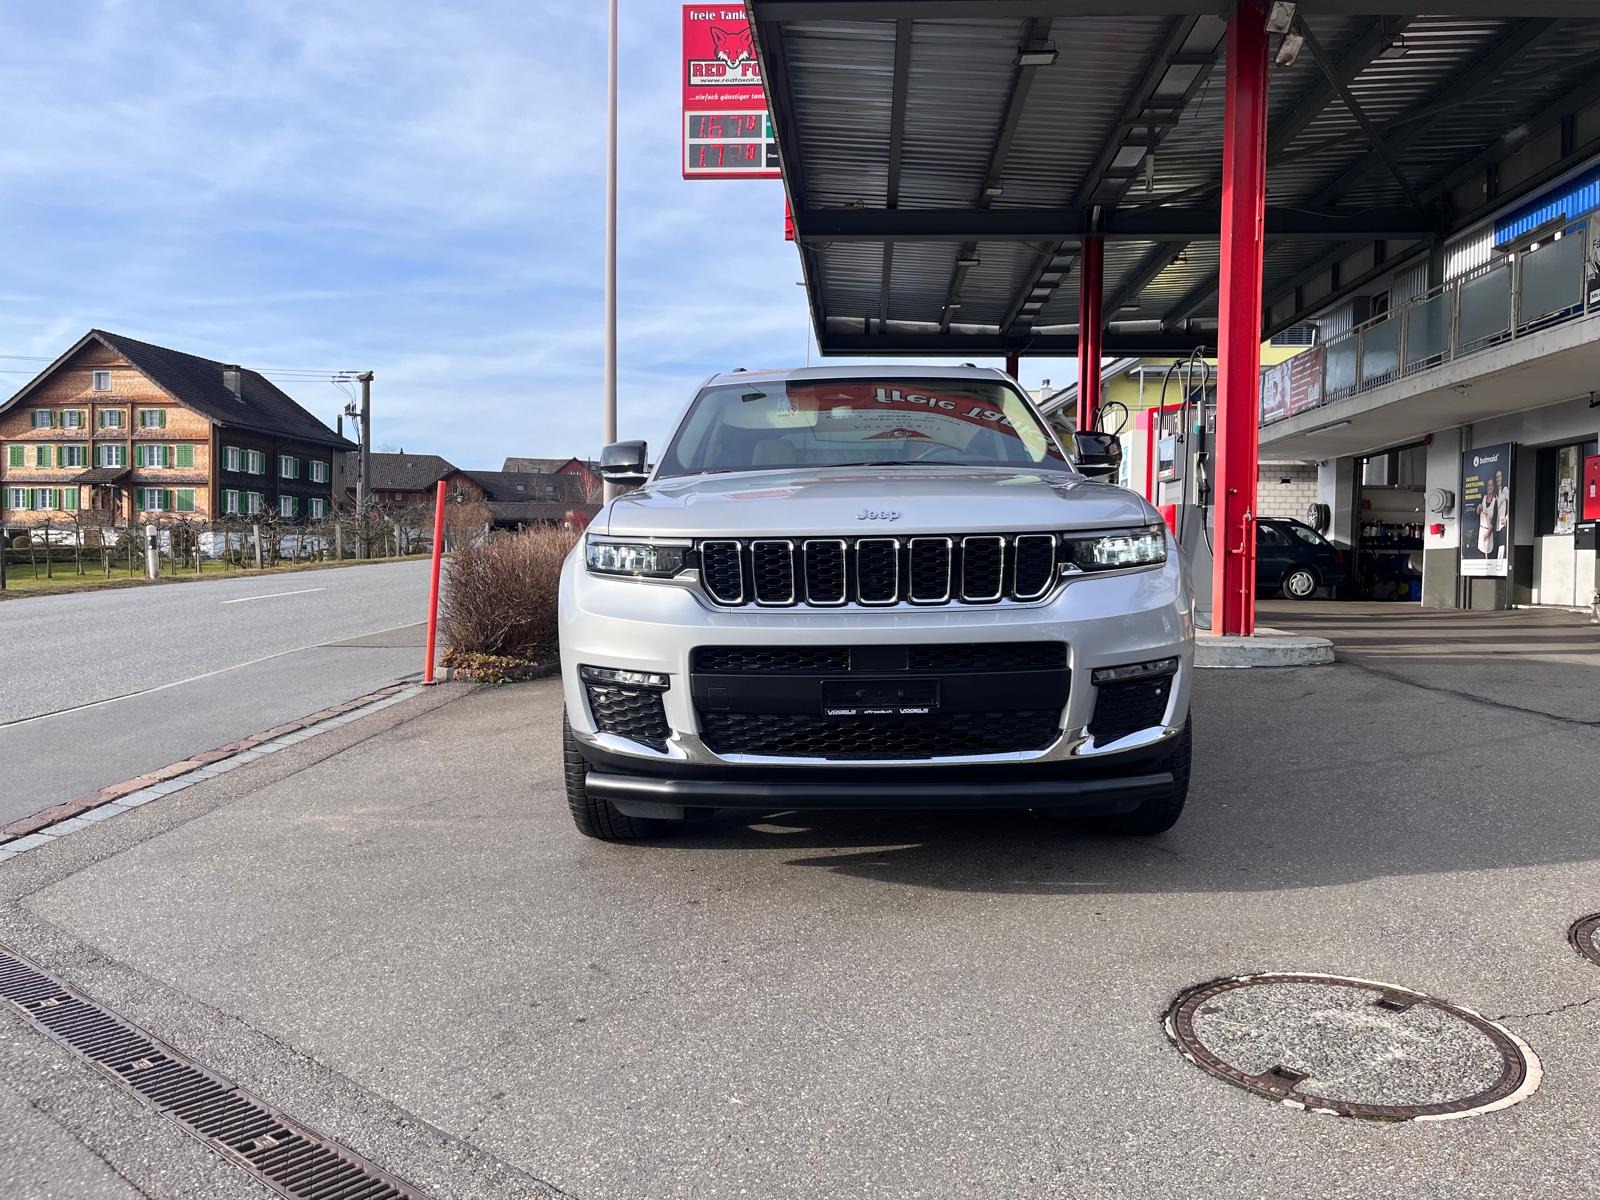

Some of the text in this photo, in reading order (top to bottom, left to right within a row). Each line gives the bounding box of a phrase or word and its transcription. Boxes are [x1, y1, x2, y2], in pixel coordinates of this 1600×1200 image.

[690, 10, 748, 20] freie Tank
[692, 63, 727, 77] RED
[1177, 434, 1185, 445] 4
[856, 509, 901, 522] Jeep
